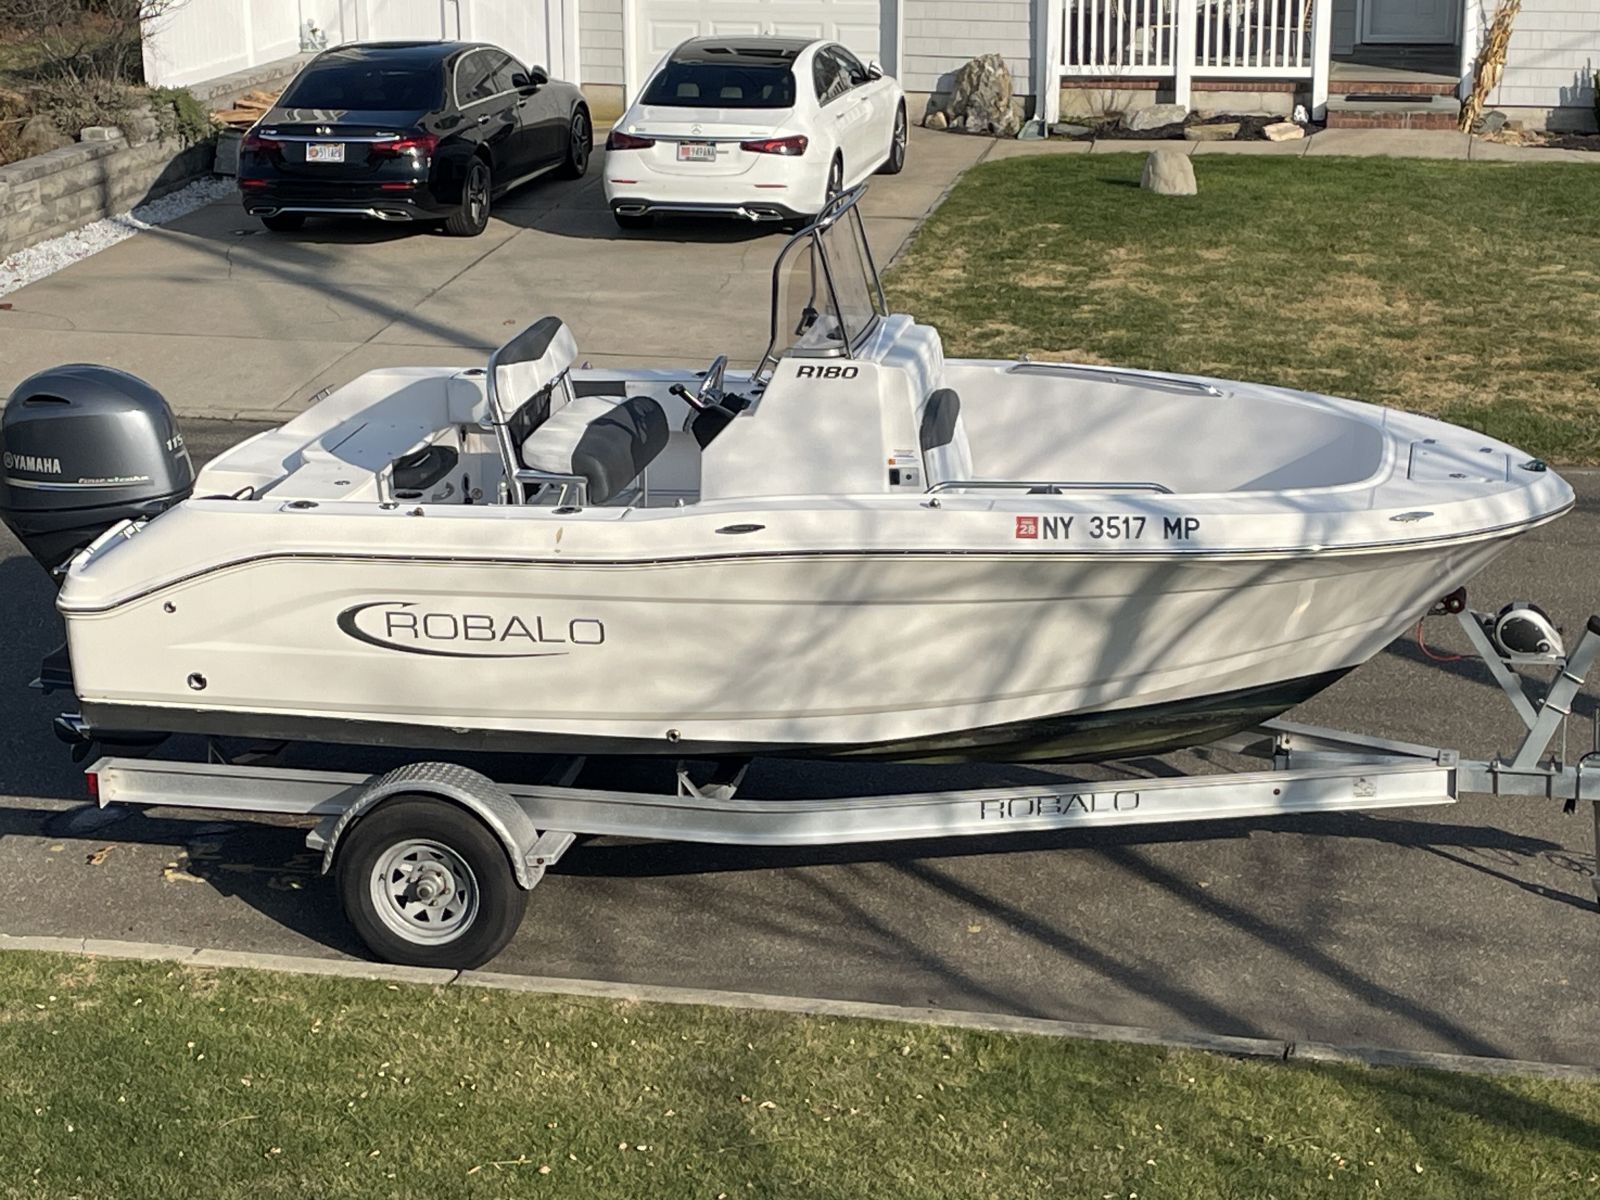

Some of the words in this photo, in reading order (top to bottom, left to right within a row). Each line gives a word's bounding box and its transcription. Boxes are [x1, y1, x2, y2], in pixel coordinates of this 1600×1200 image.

[796, 366, 858, 379] R180
[13, 455, 61, 474] YAMAHA
[1043, 516, 1074, 539] NY
[1089, 516, 1147, 539] 3517
[1163, 517, 1200, 540] MP
[385, 611, 605, 645] ROBALO
[981, 791, 1140, 820] ROBALO
